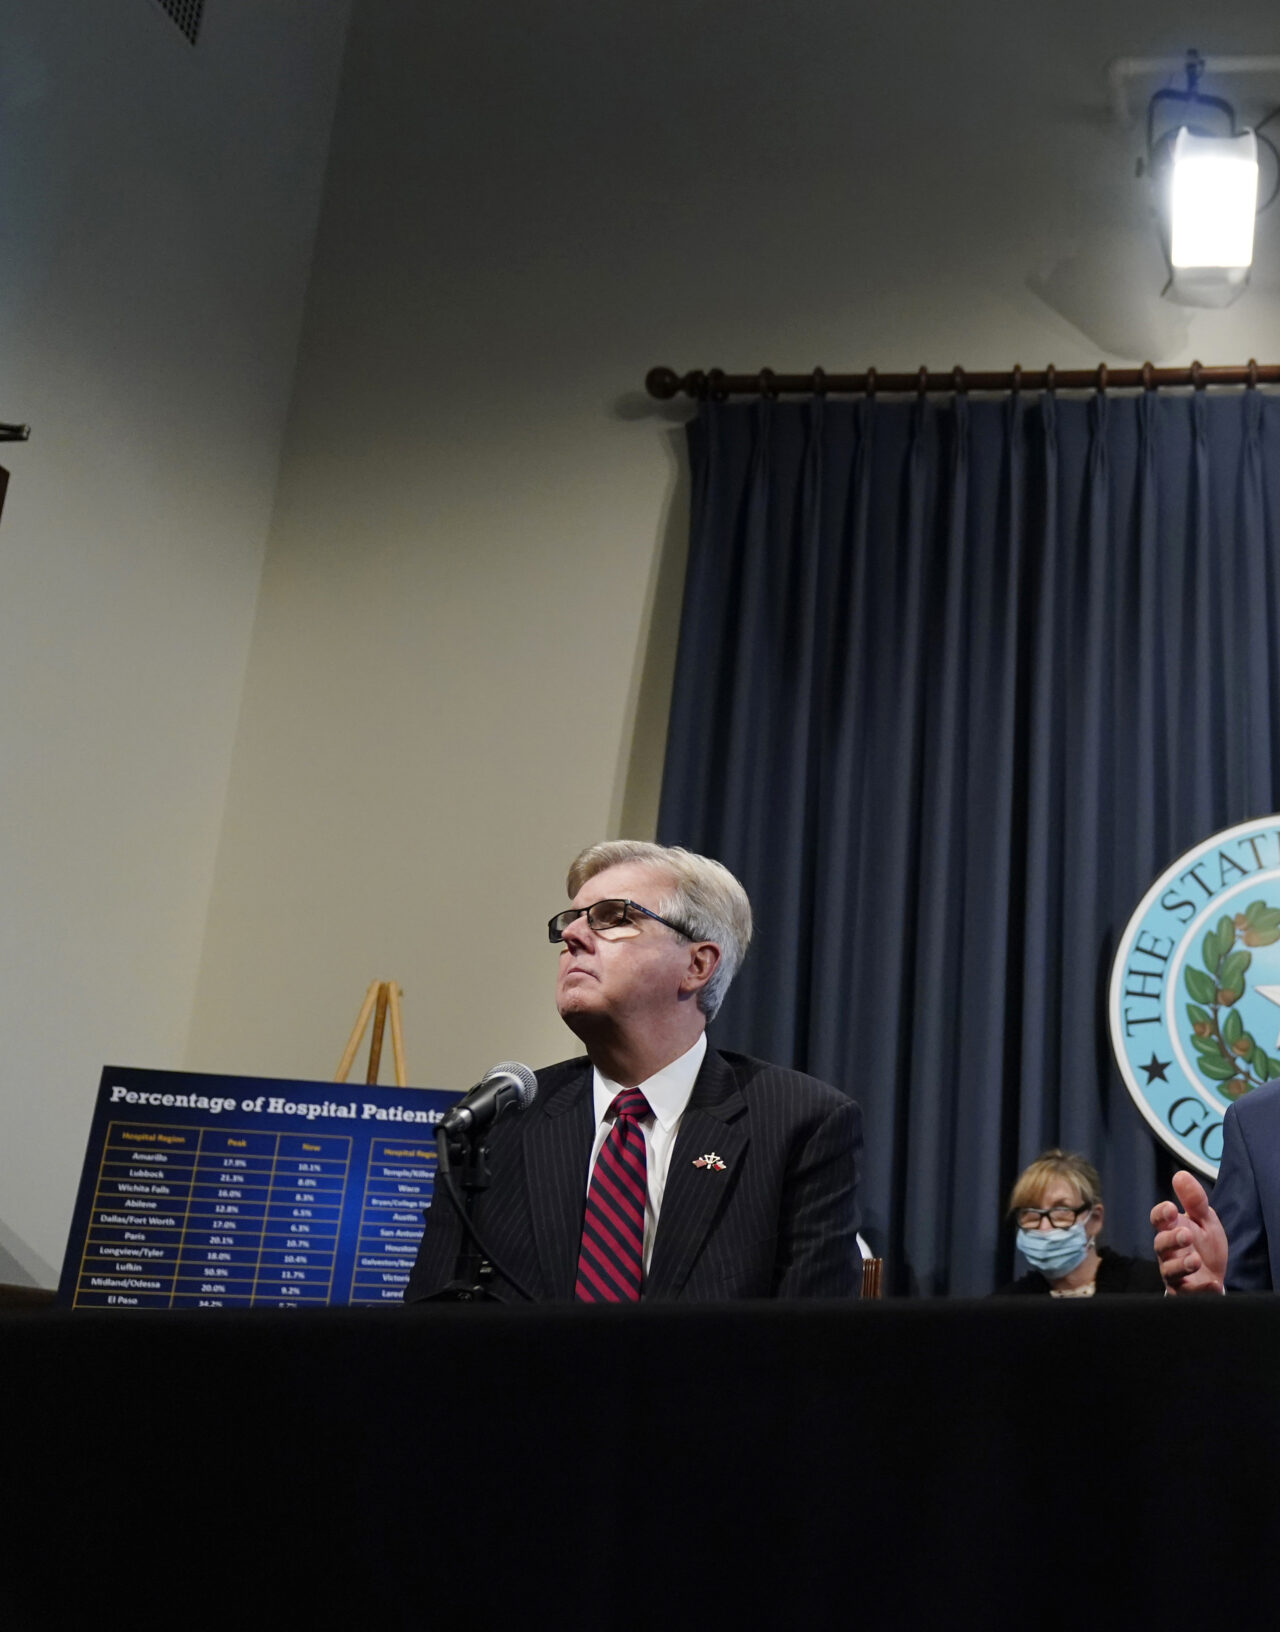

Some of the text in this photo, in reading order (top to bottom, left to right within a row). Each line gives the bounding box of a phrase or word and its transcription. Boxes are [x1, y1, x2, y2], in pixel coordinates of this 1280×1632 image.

[1125, 930, 1175, 1037] THE
[110, 1086, 445, 1123] Percentage of Hospital Patients
[122, 1132, 186, 1144] Hospital Region
[227, 1138, 247, 1147] Peak
[302, 1143, 321, 1151] Now
[132, 1152, 168, 1162] Amarillo
[384, 1148, 438, 1159] Hospital Regio
[130, 1169, 164, 1179] Lubbock
[383, 1168, 435, 1178] Temple/Killee
[118, 1183, 170, 1194] Wichita Falls
[398, 1184, 420, 1193] Waco
[124, 1199, 157, 1208] Abilene
[100, 1214, 176, 1226] Dallas/Fort Worth
[392, 1213, 418, 1222] Austin
[124, 1232, 146, 1241] Paris
[380, 1228, 424, 1238] San Antoni
[100, 1246, 164, 1258] Longview/Tyler
[384, 1244, 418, 1252] Houston
[116, 1262, 142, 1272] Lufkin
[91, 1277, 161, 1289] Midland/Odessa
[108, 1296, 138, 1305] El Paso
